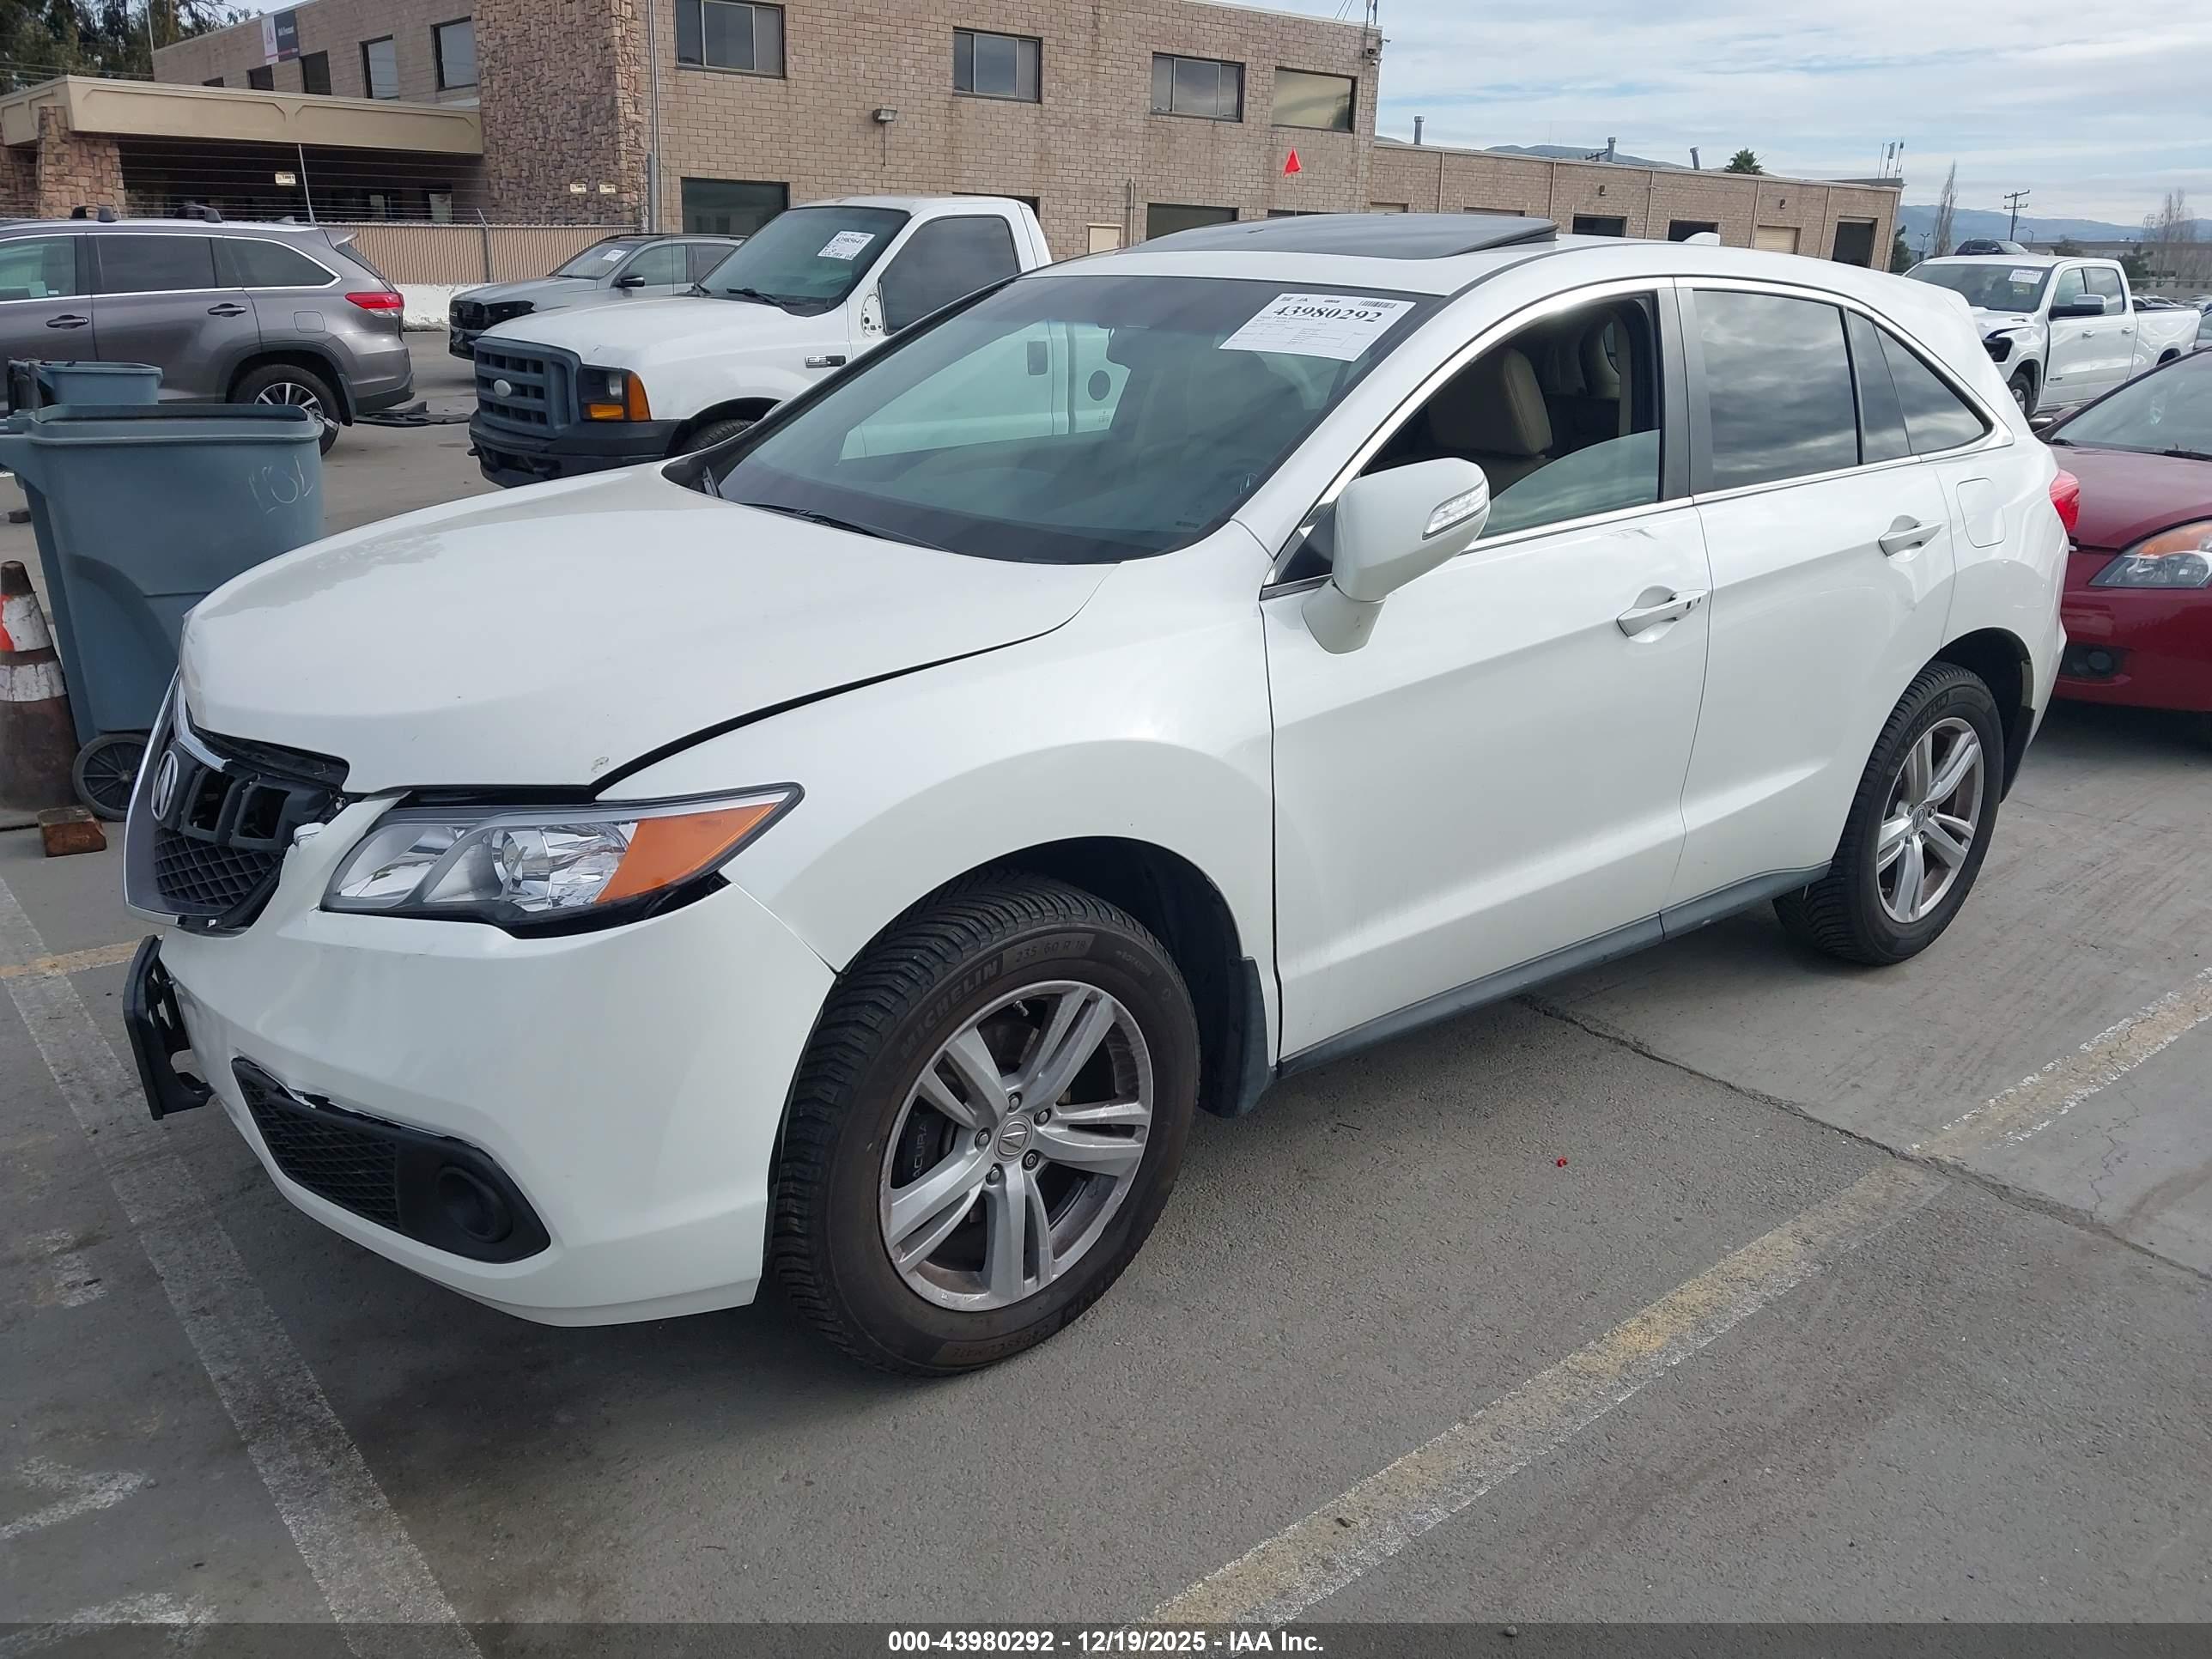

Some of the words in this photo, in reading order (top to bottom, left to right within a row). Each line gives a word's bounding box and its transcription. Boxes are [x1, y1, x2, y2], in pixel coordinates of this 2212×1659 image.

[1273, 305, 1384, 324] 43980292
[901, 958, 1000, 1054] MICHELIN
[1016, 945, 1037, 963] 235
[1044, 940, 1059, 955] 60
